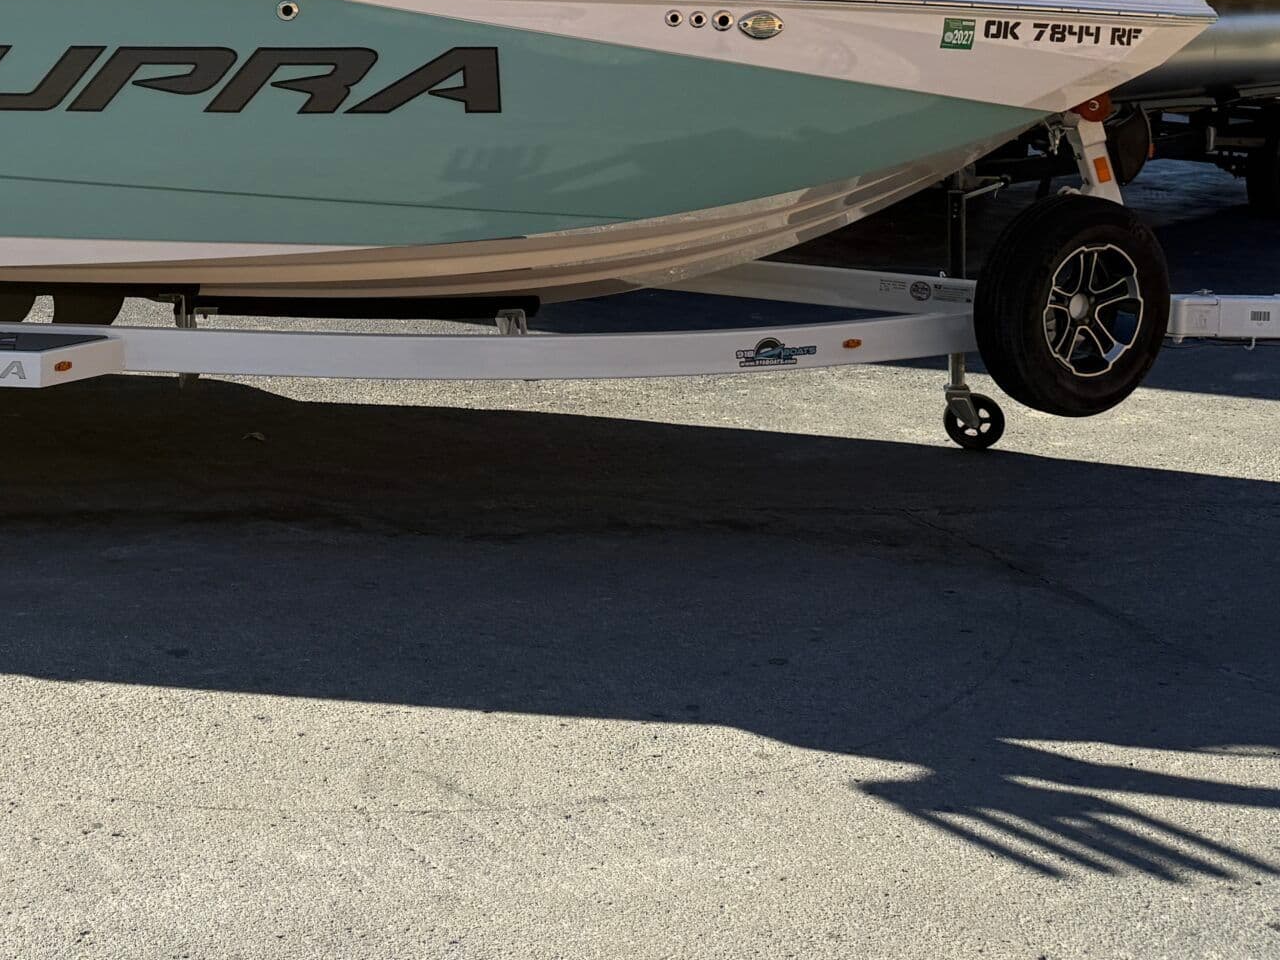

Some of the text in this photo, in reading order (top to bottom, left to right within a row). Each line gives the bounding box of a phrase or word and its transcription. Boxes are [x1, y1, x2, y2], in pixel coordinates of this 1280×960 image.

[952, 30, 974, 44] 2027
[984, 20, 1143, 46] OK 7844 RF
[783, 346, 816, 357] BOATS
